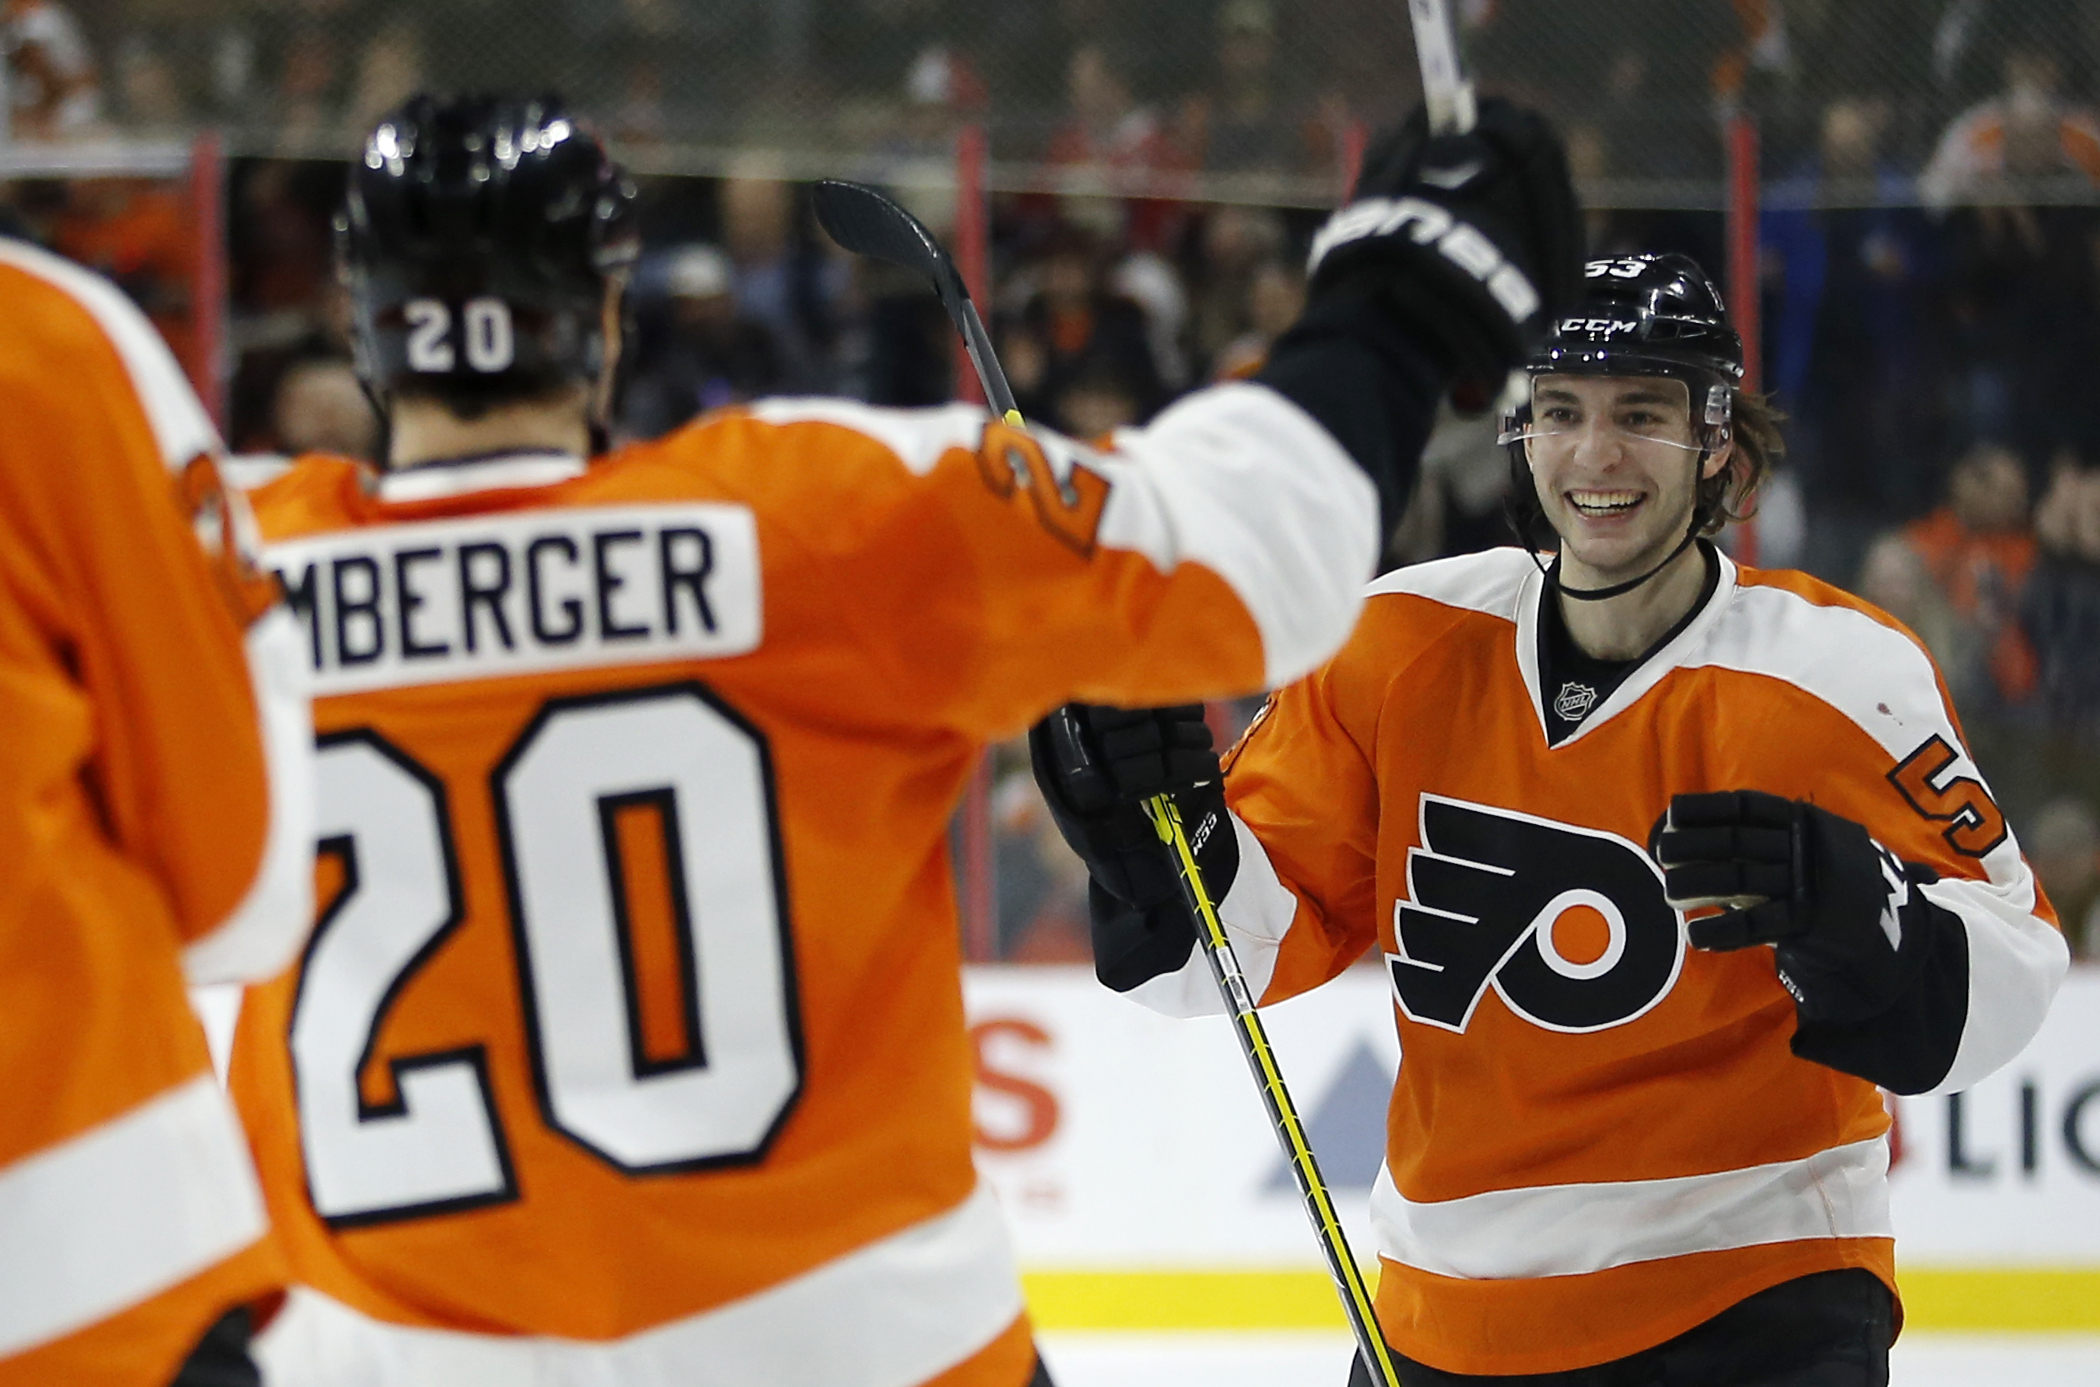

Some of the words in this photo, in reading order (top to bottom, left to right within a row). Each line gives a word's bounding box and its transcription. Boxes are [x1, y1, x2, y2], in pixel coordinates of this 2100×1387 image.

[1584, 260, 1647, 278] 53
[403, 297, 515, 374] 20
[1560, 318, 1638, 333] CCM
[974, 421, 1114, 561] 2
[1885, 732, 2009, 859] 5
[288, 679, 807, 1230] 20
